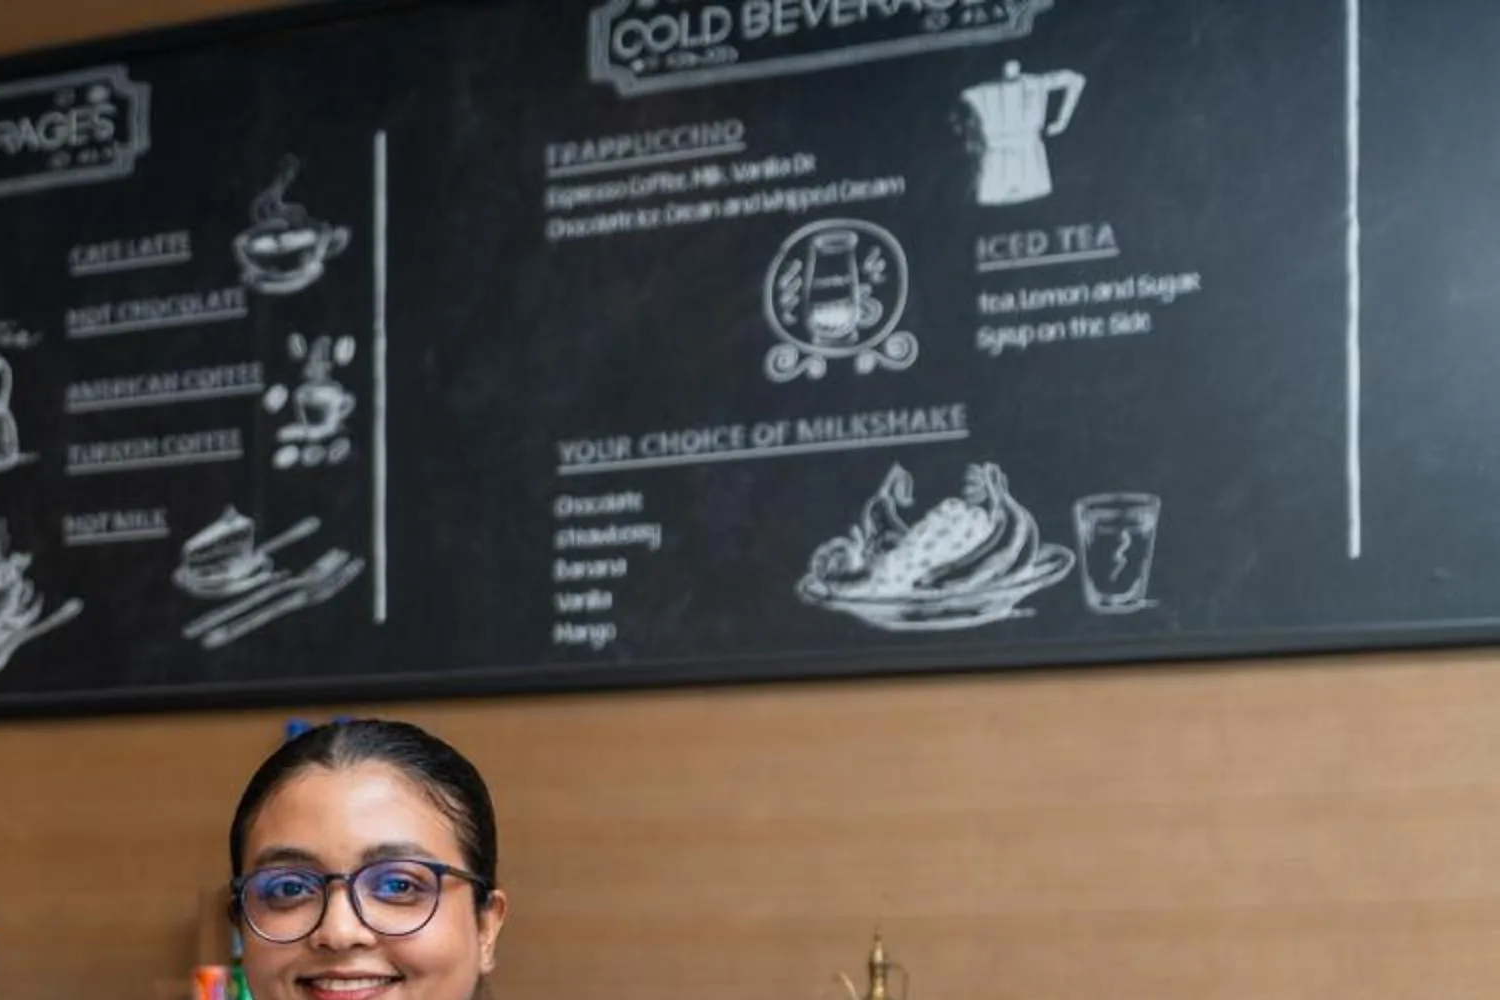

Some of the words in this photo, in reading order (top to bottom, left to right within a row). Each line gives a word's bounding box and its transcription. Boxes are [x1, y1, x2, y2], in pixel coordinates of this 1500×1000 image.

[613, 5, 733, 59] COLD
[742, 0, 987, 40] BEVER
[546, 118, 744, 166] FRAPPUCCINO
[976, 230, 1048, 261] ICED
[1057, 223, 1116, 251] TEA
[558, 435, 632, 464] YOUR
[639, 424, 747, 457] CHOICE
[752, 420, 790, 448] OF
[797, 403, 967, 441] MILKSHAKE
